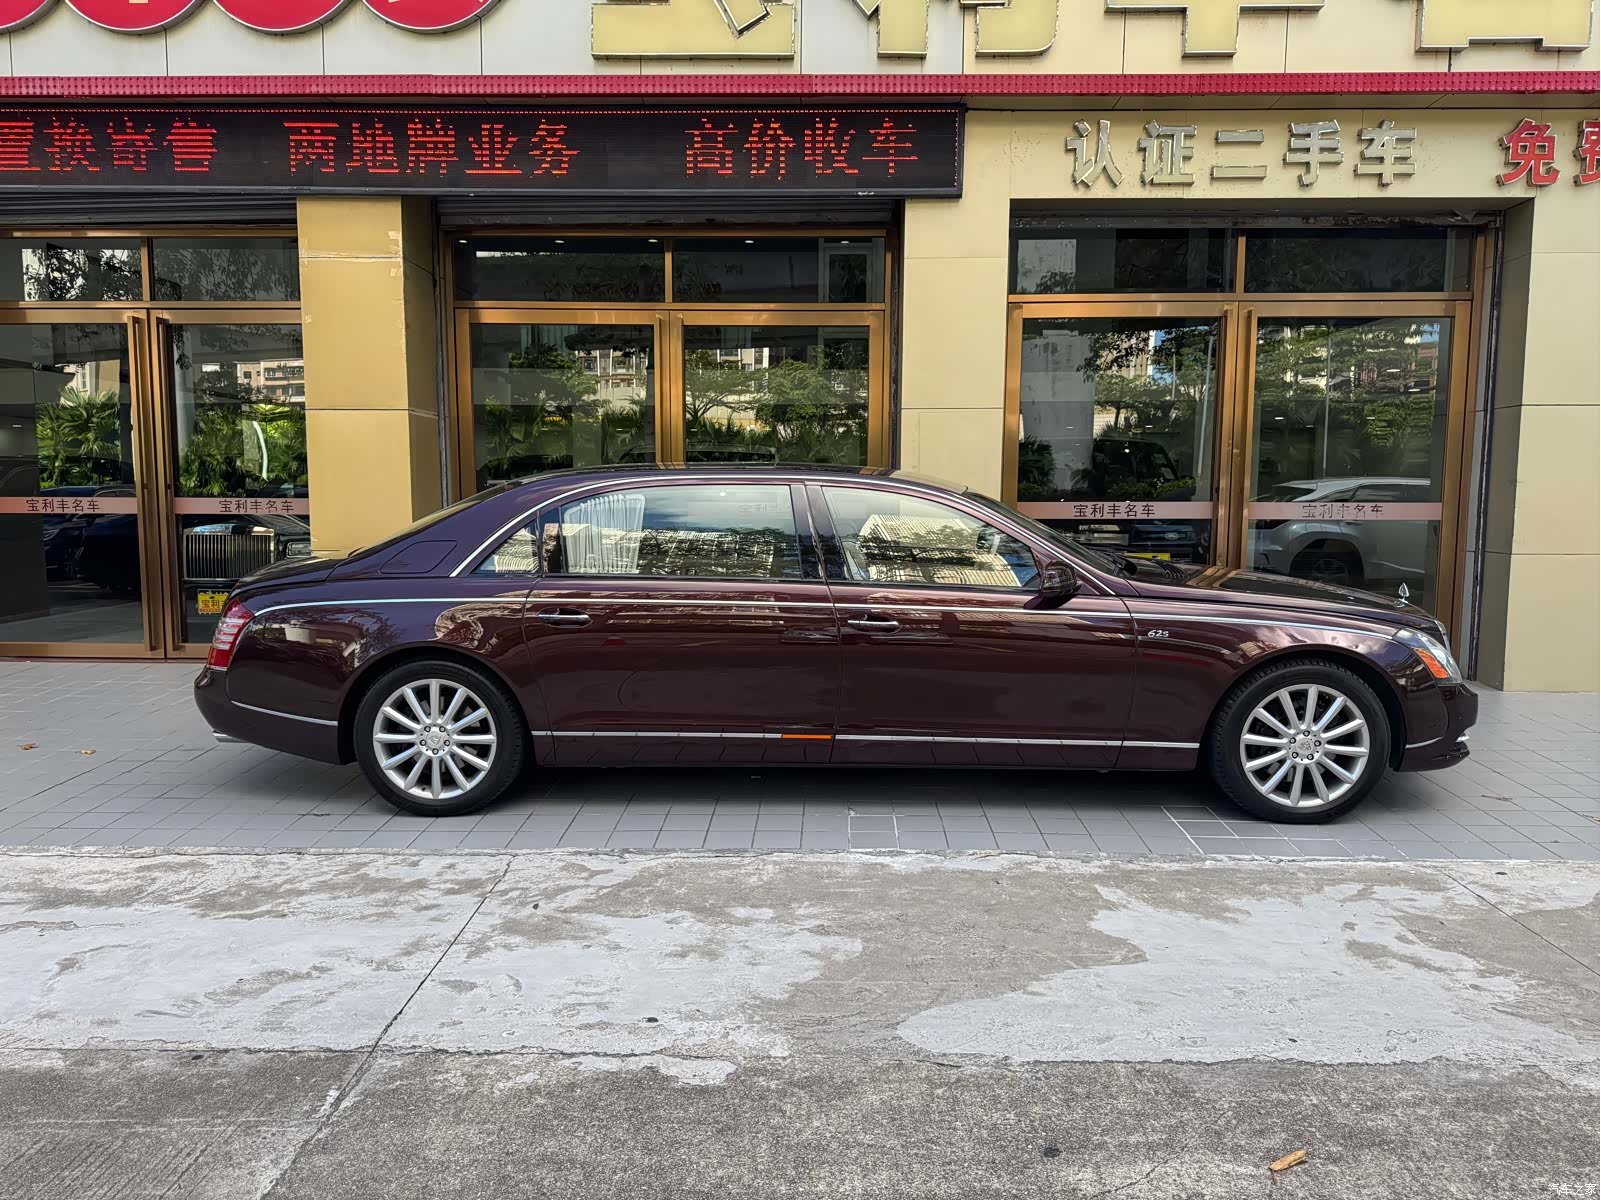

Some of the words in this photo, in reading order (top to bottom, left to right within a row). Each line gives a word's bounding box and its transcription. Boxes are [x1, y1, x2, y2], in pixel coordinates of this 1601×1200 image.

[283, 117, 580, 176] 两地牌业务
[684, 117, 919, 178] 高价收车
[1066, 118, 1418, 188] 认证二手车
[25, 498, 101, 513] 宝利丰名车
[218, 498, 295, 514] 宝利丰名车
[1073, 502, 1156, 518] 宝利丰名车
[1302, 503, 1384, 519] 宝利丰名车
